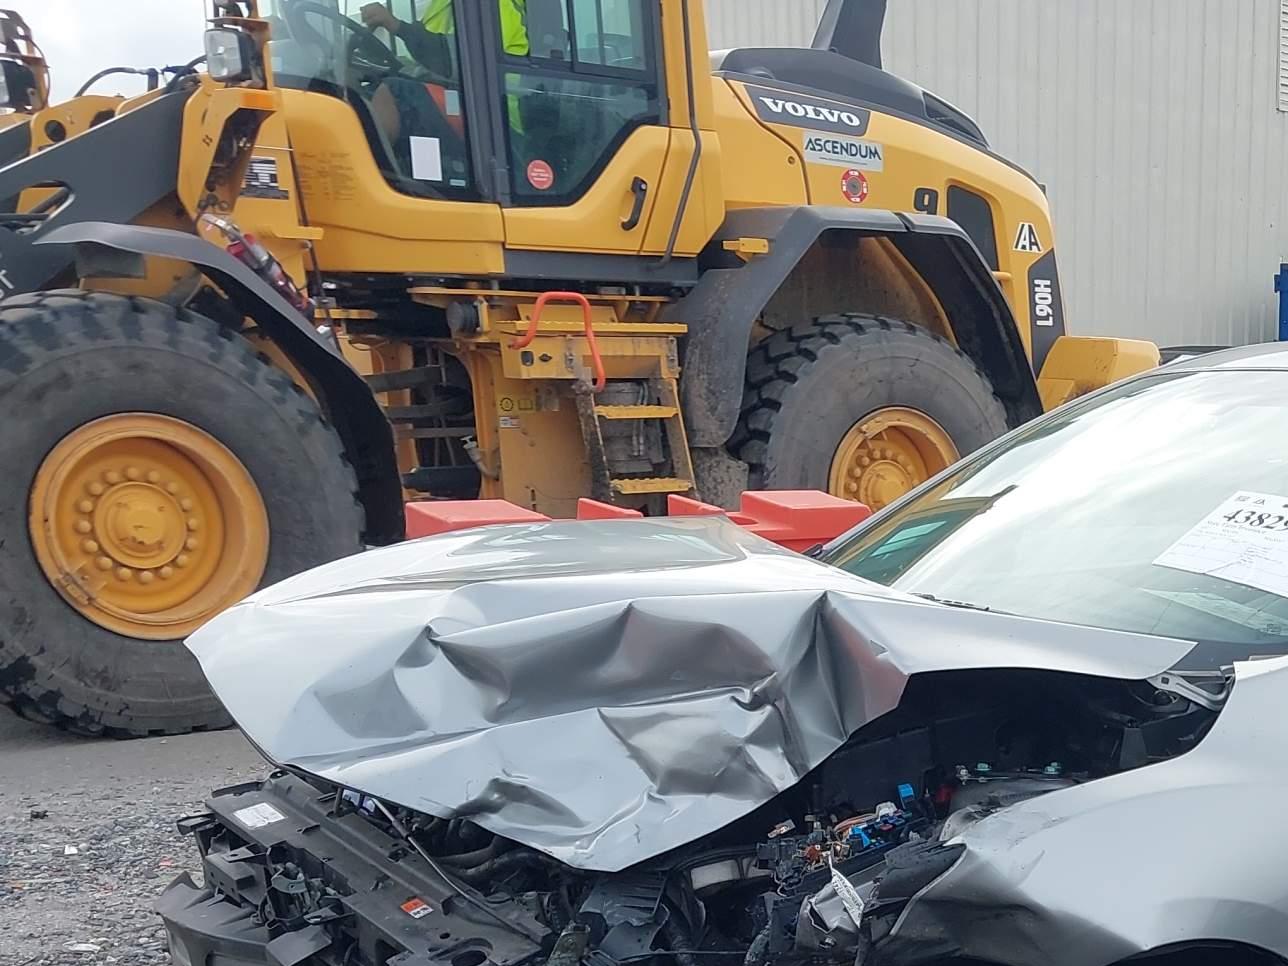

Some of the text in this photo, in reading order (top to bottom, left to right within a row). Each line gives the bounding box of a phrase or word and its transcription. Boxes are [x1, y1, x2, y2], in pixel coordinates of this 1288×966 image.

[759, 96, 861, 127] VOLVO
[805, 137, 882, 161] ASCENDUM
[914, 187, 938, 215] 9
[1033, 279, 1054, 326] L90H
